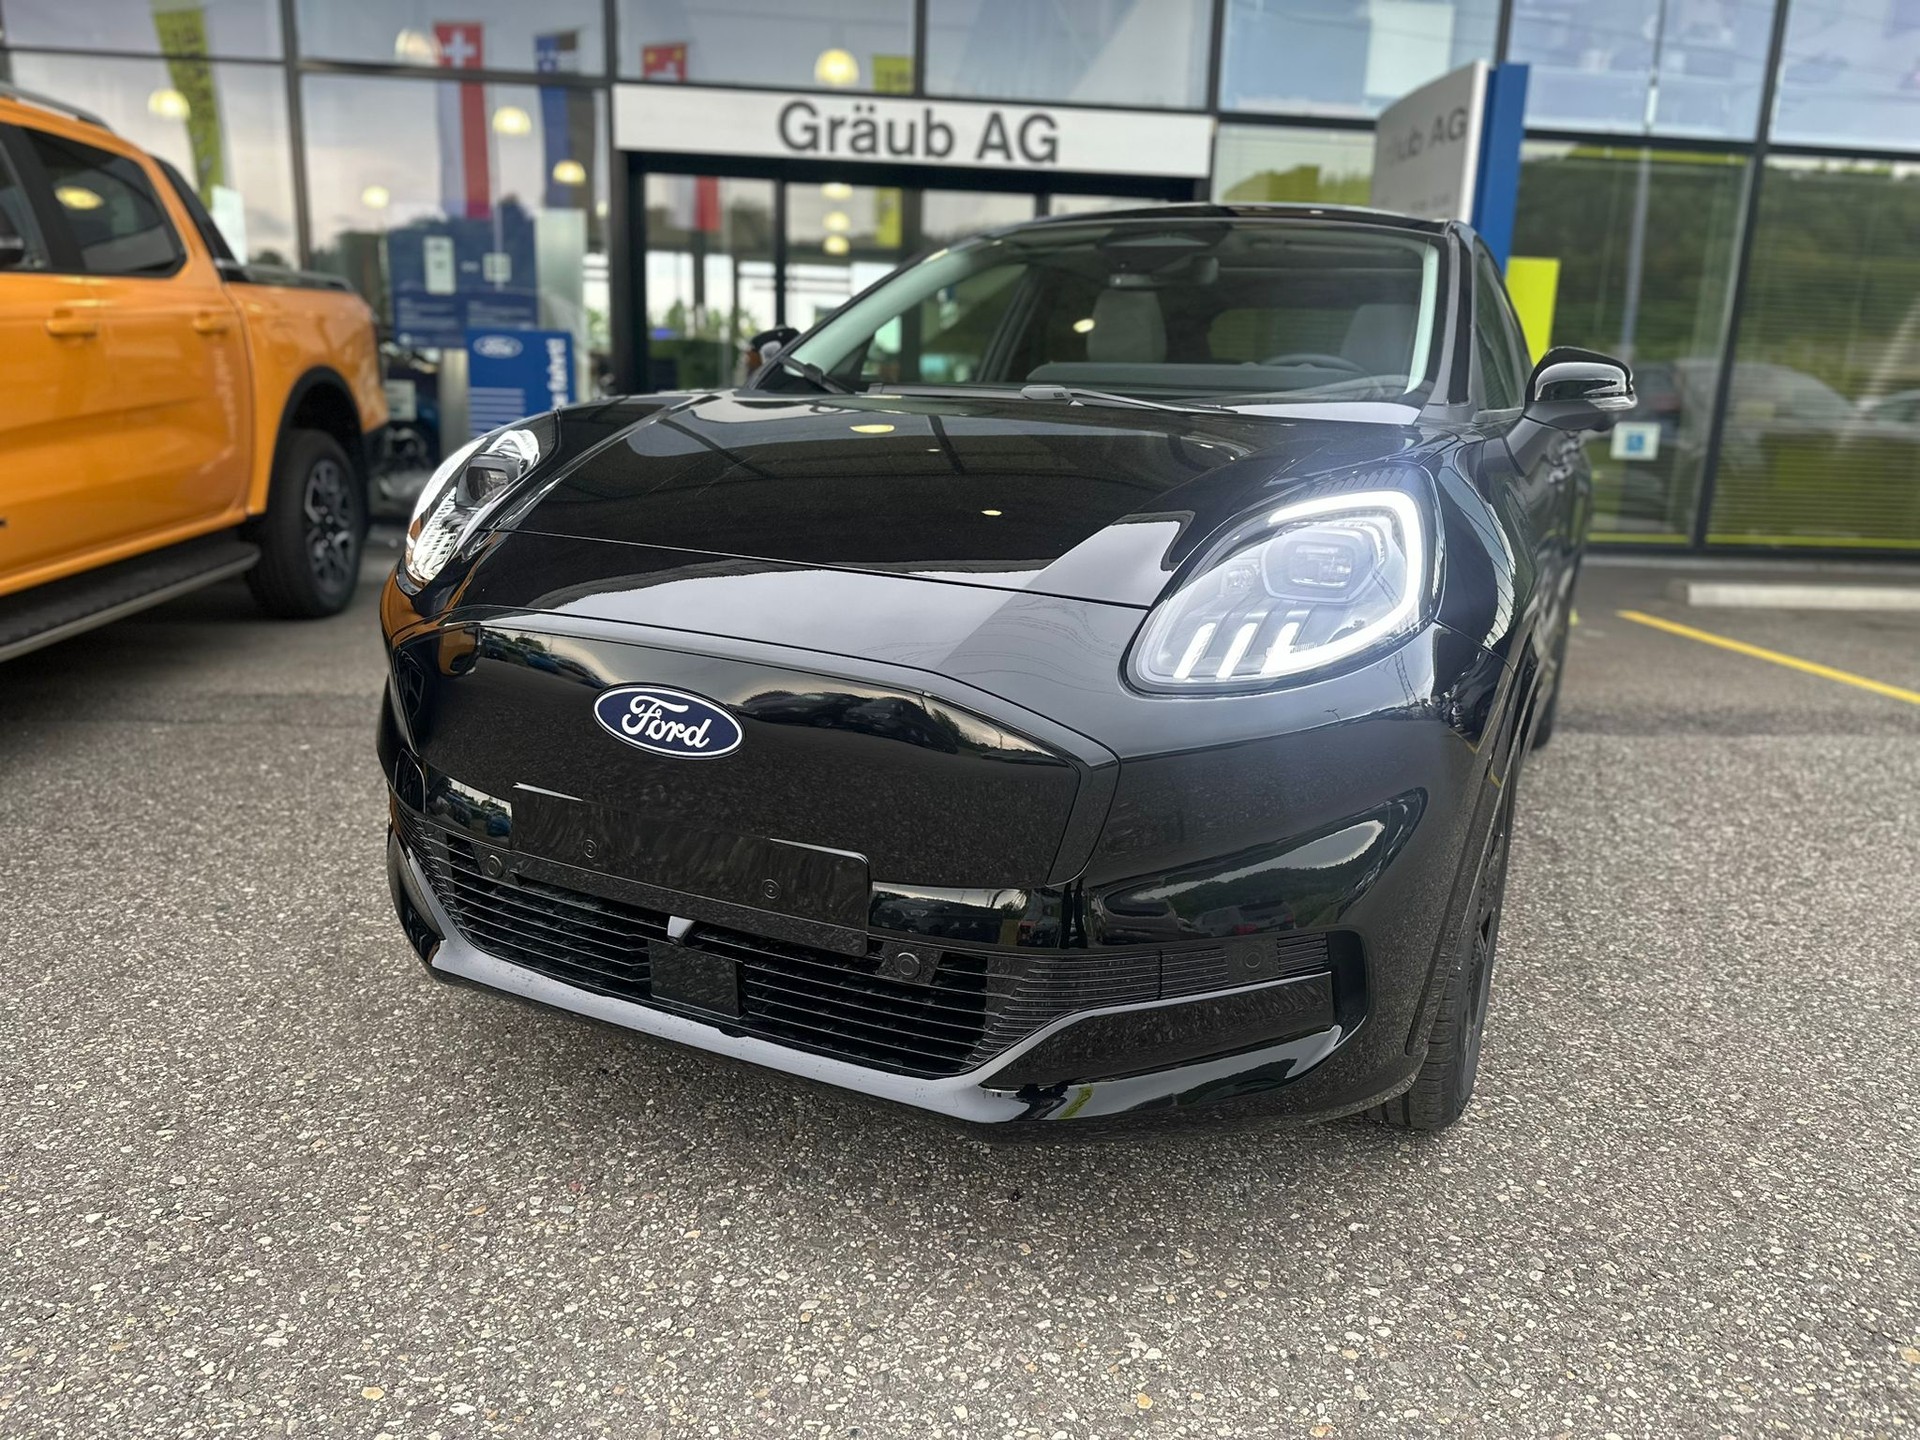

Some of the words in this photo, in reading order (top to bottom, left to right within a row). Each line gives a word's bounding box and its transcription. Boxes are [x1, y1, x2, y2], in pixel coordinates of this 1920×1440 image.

[778, 100, 955, 158] Gräub
[976, 111, 1059, 163] AG
[1427, 107, 1468, 148] AG
[621, 695, 713, 749] Ford
